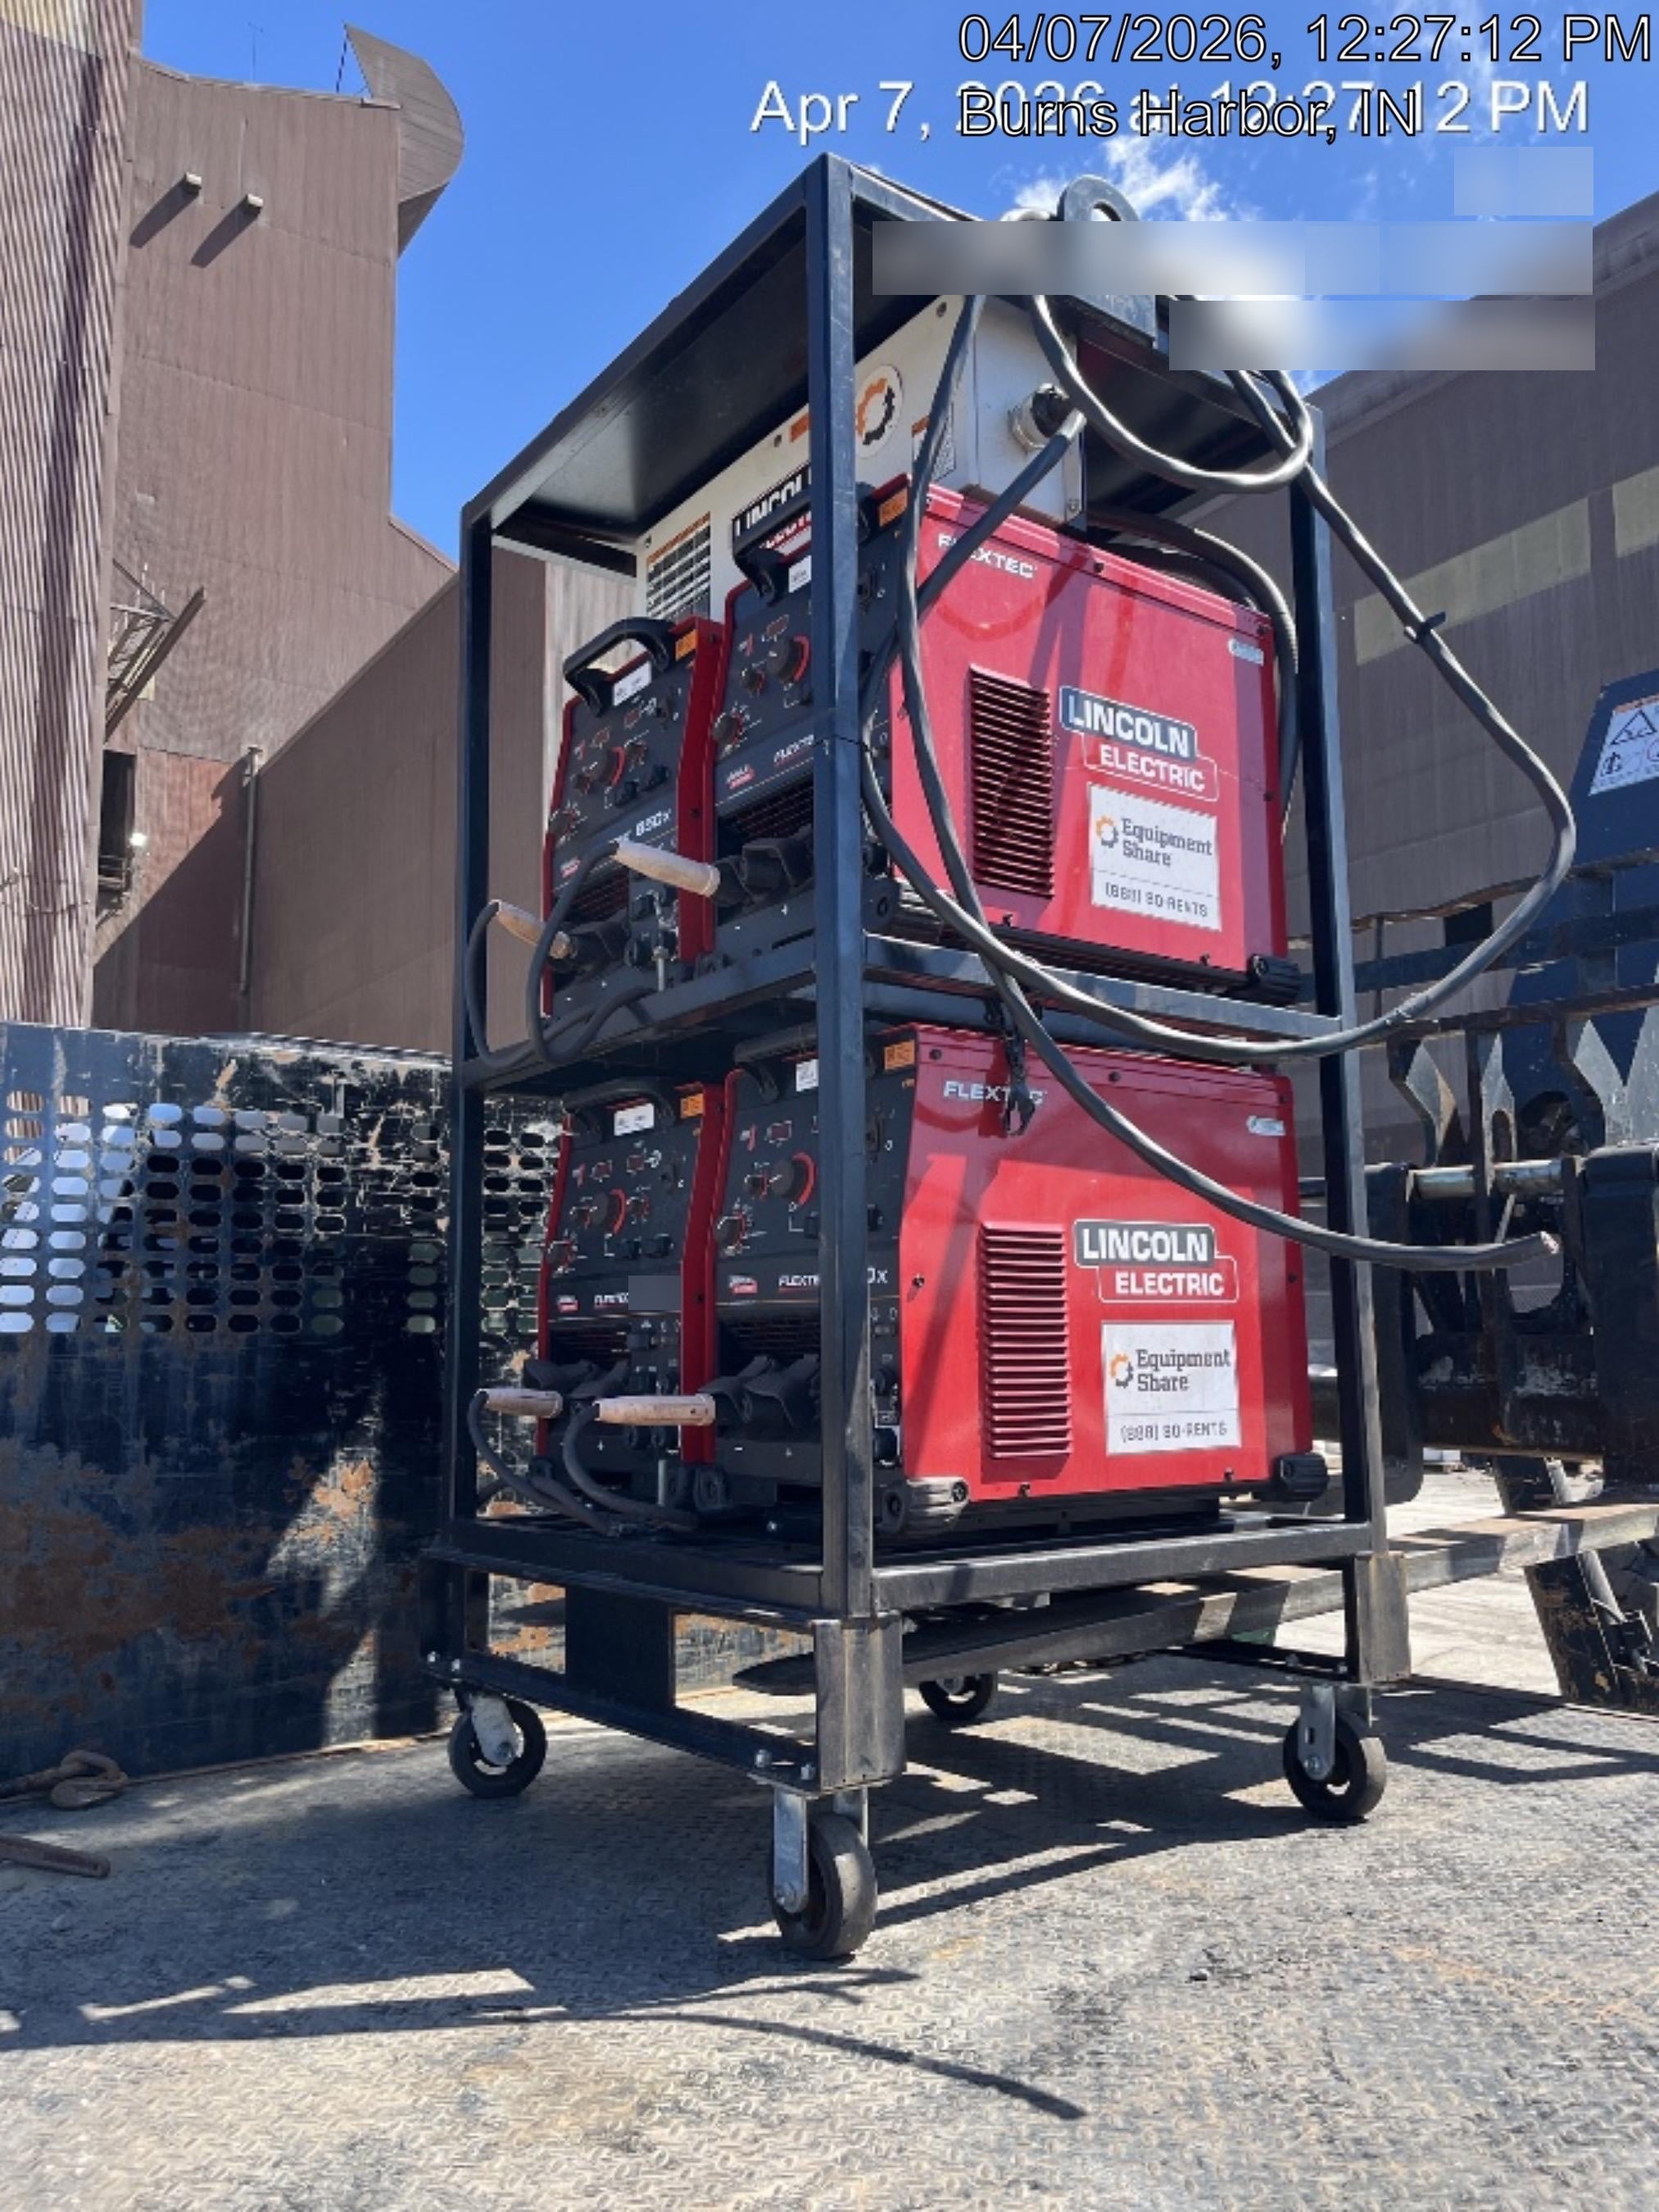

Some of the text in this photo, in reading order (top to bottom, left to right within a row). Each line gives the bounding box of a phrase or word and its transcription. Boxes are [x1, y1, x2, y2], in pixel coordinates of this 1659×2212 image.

[1067, 694, 1191, 759] LINCOLN
[1099, 742, 1208, 793] ELECTRIC
[1121, 818, 1213, 857] Equipment
[1122, 839, 1173, 868] Share
[1082, 1227, 1209, 1262] LINCOLN
[1114, 1270, 1226, 1297] ELECTRIC
[1135, 1349, 1231, 1373] Equipment
[1137, 1372, 1190, 1393] Share
